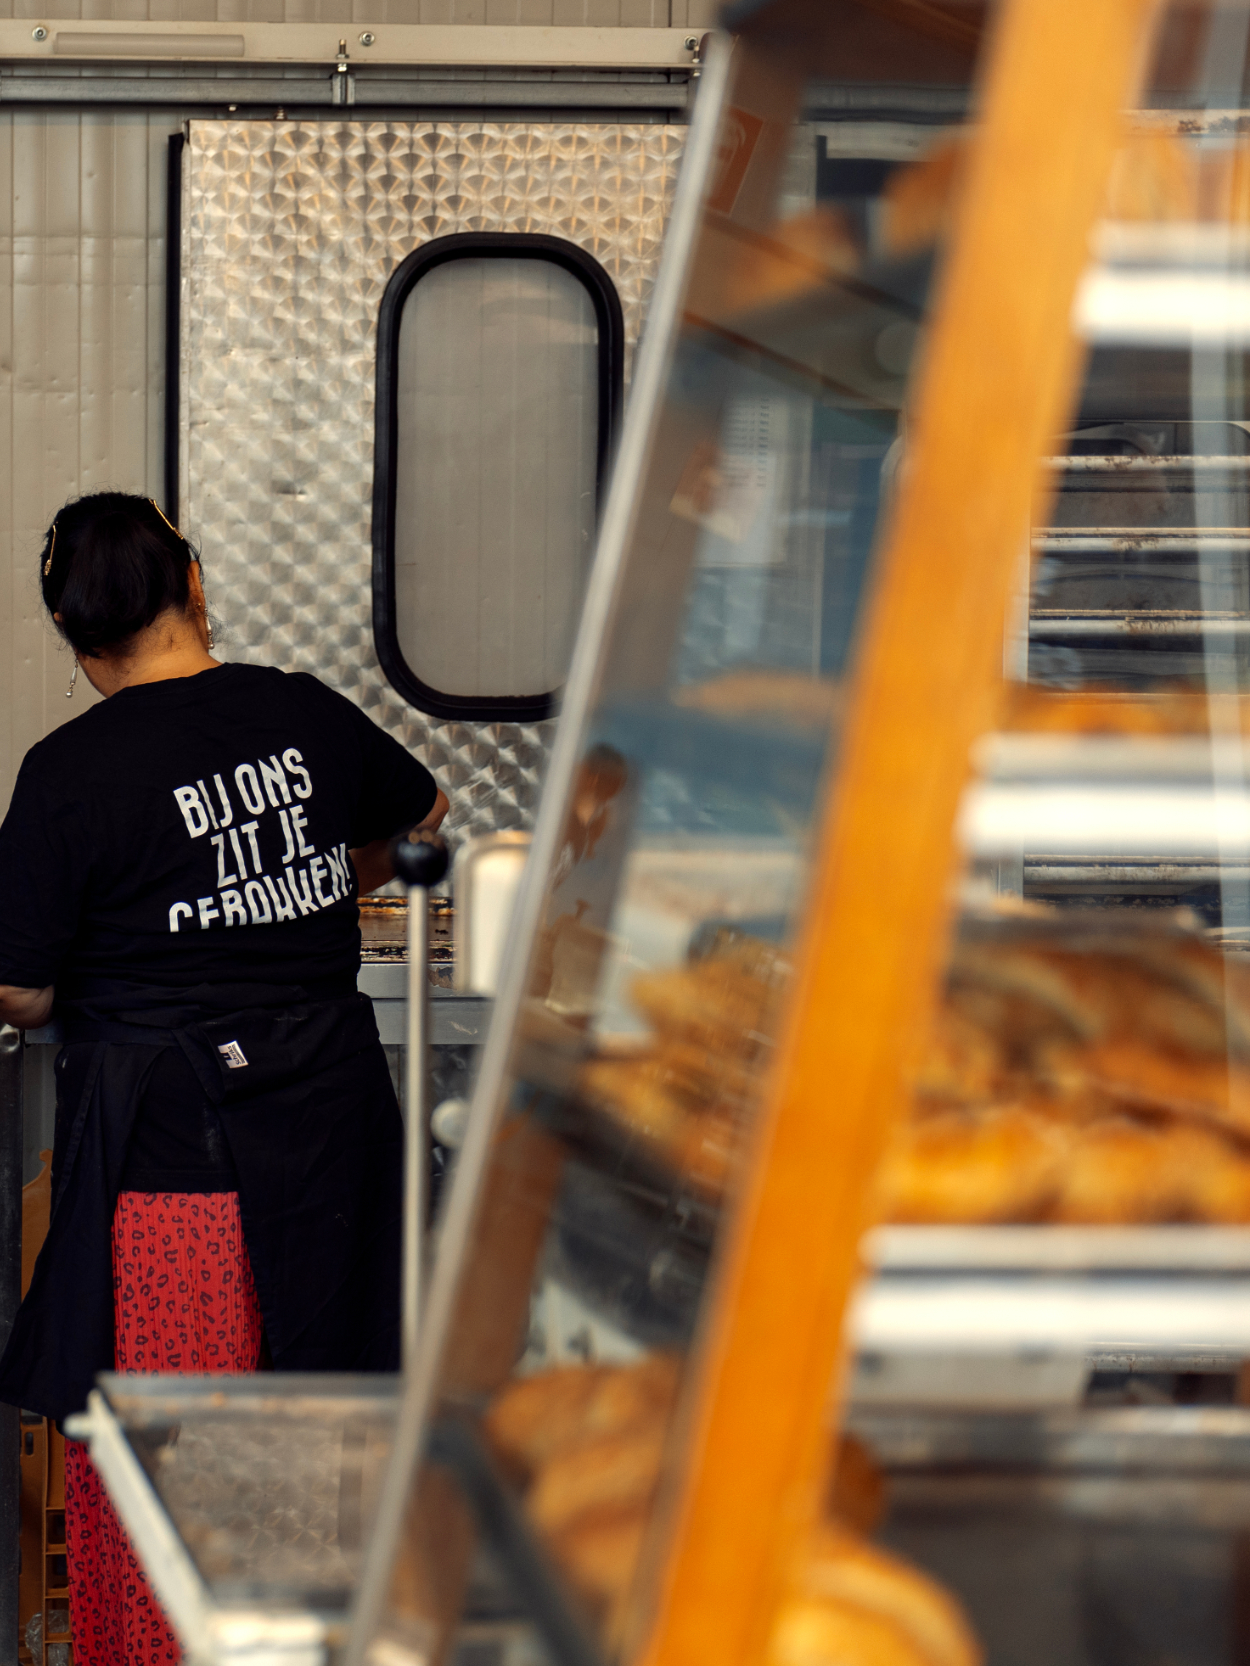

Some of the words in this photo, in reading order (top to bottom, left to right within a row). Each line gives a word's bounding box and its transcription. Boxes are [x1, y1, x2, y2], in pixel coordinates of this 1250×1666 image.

[173, 774, 233, 838] BIJ
[234, 748, 313, 815] ONS
[210, 820, 263, 888] ZIT
[278, 805, 315, 864] JE
